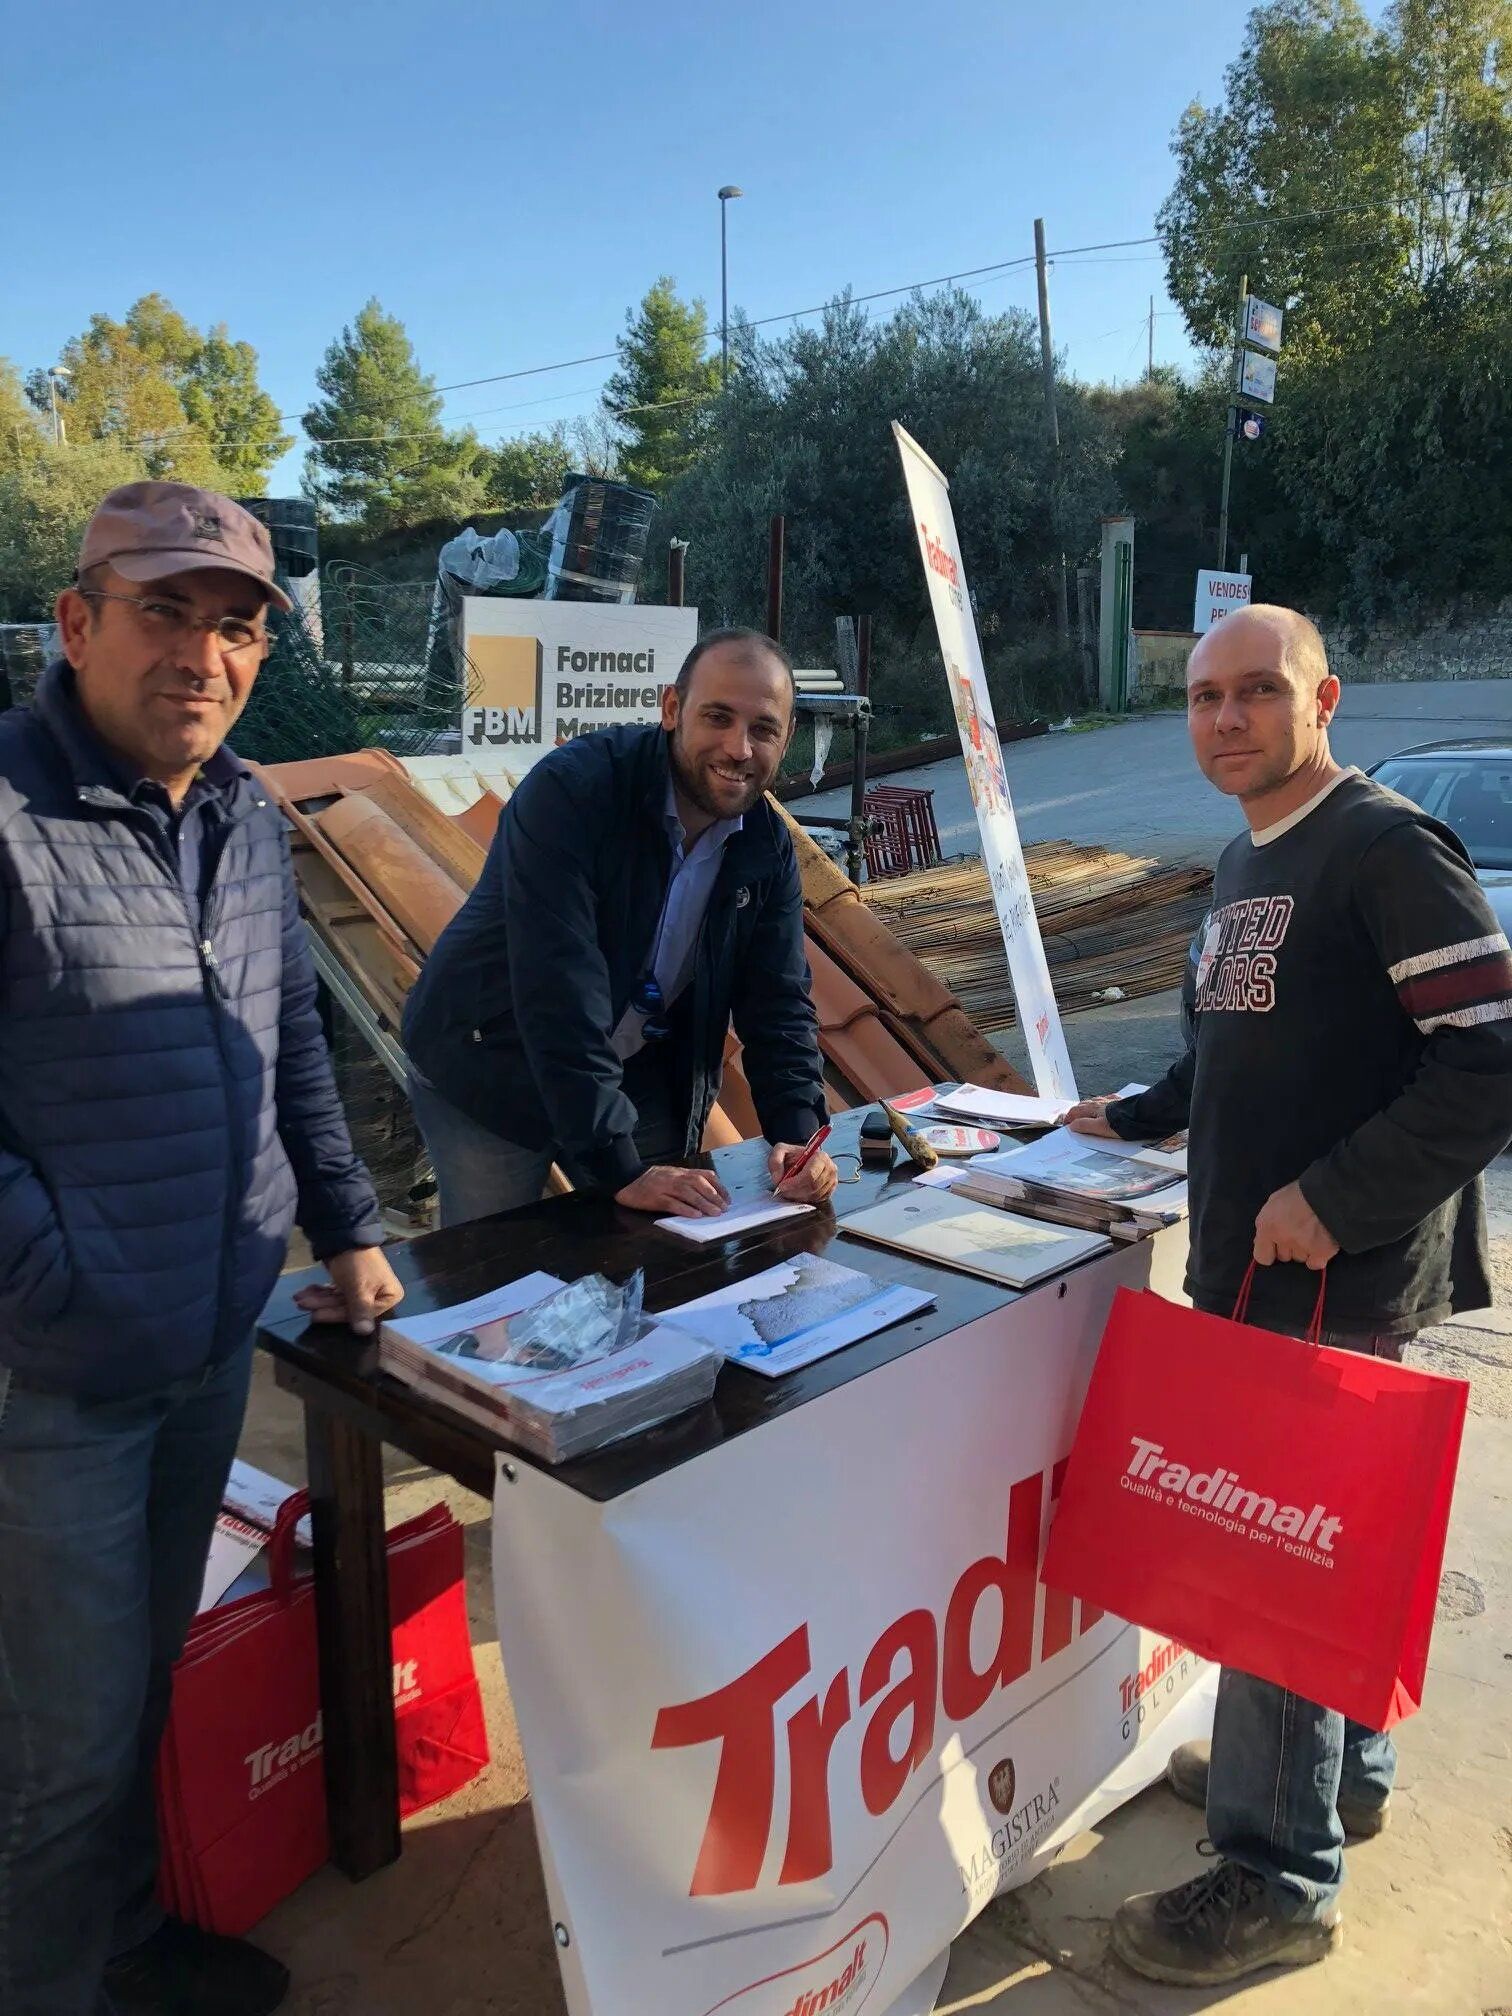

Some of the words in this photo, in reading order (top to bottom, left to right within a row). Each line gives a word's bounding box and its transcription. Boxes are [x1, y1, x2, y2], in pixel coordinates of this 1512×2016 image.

[556, 682, 676, 709] Briziarel
[557, 645, 655, 673] Fornaci
[468, 707, 537, 741] FBM
[1120, 1475, 1163, 1503] Qualità
[1166, 1496, 1174, 1507] e
[1178, 1498, 1246, 1535] tecnologia
[1249, 1527, 1273, 1546] per
[1276, 1535, 1336, 1570] l'edilizia
[1125, 1436, 1344, 1552] Tradimalt
[651, 1456, 1105, 1897] Tradi
[1118, 1638, 1184, 1715] Tradim
[959, 1782, 1060, 1894] MAGISTRA
